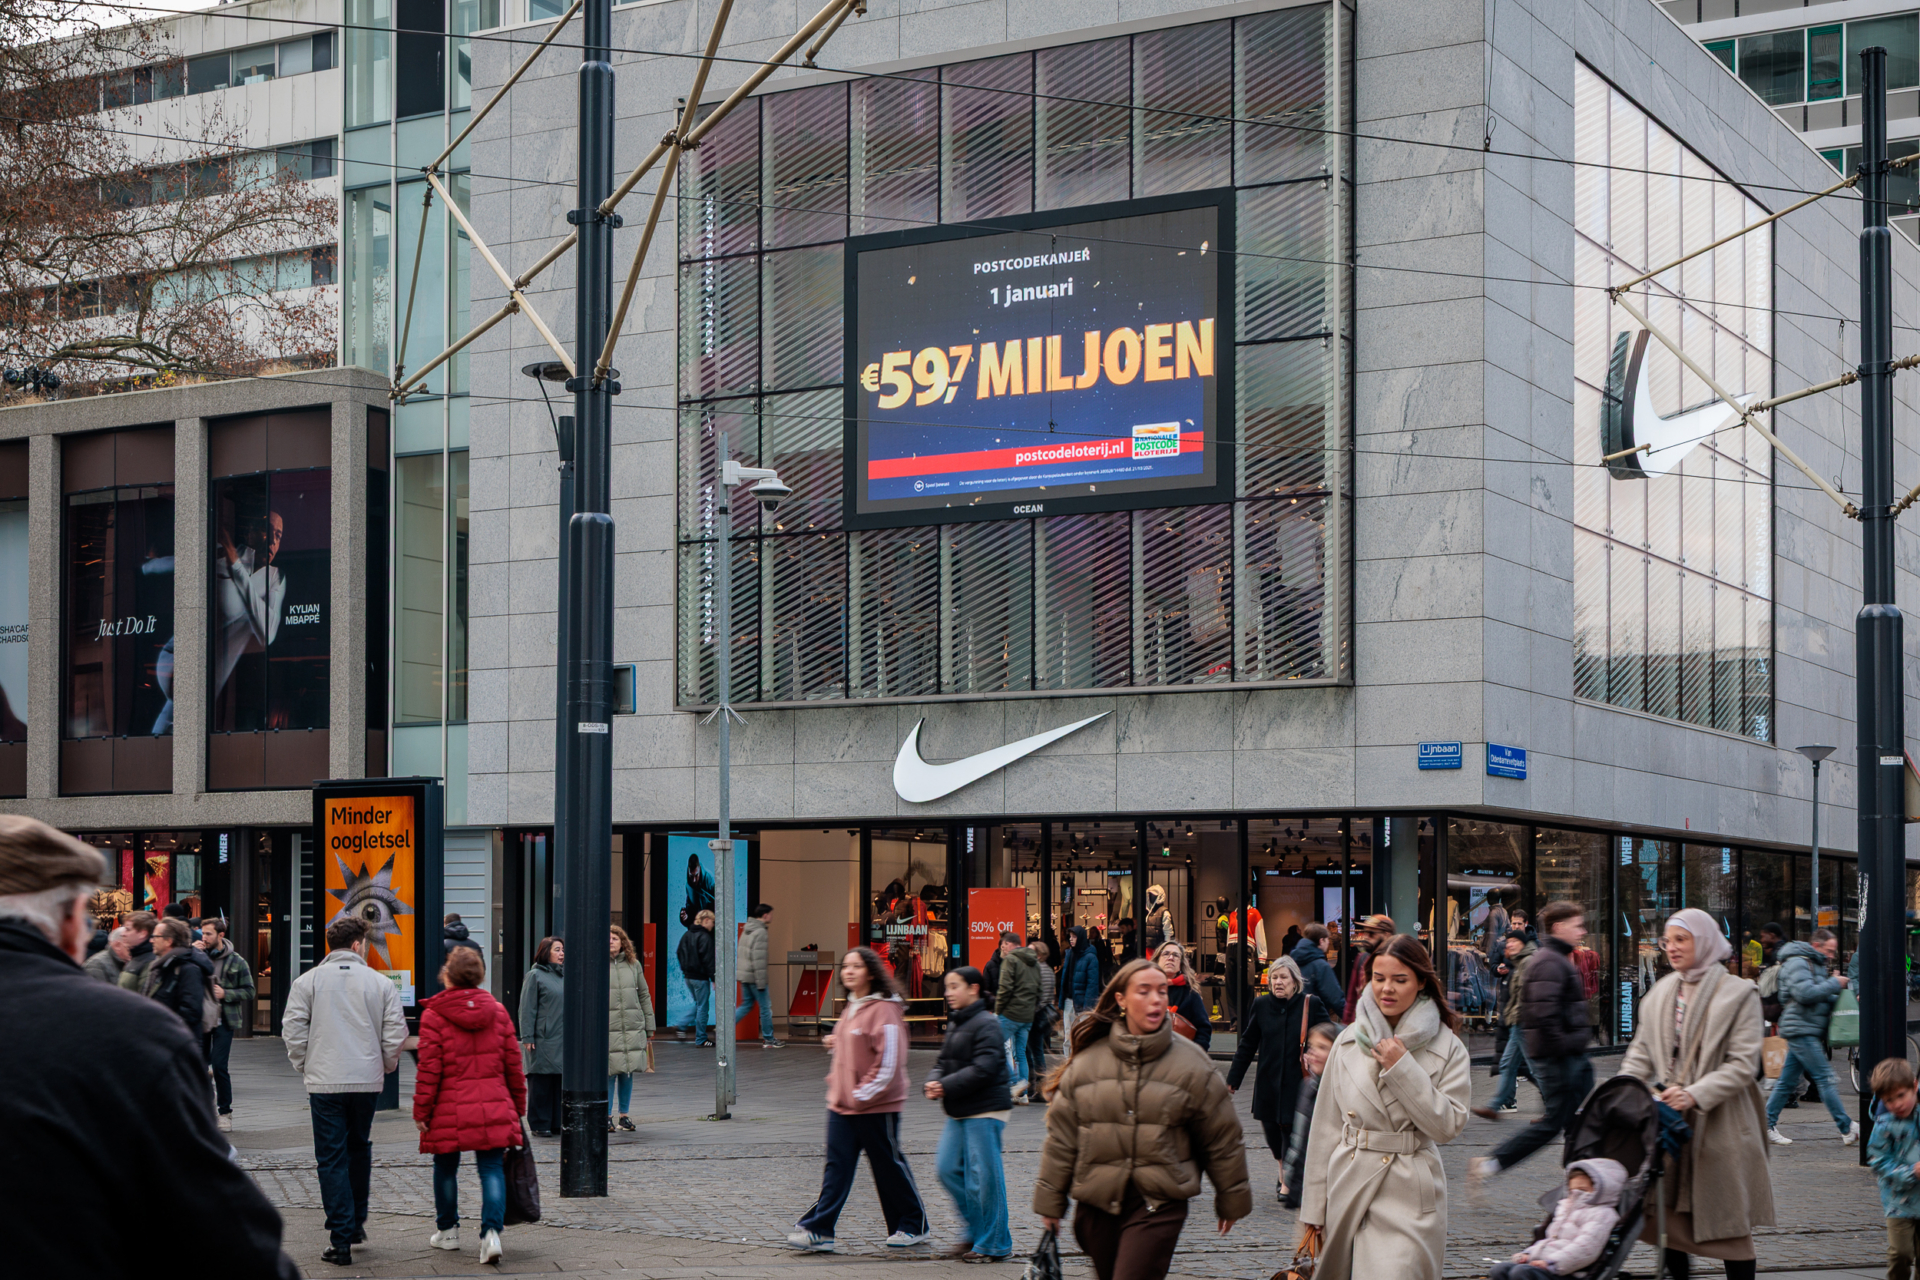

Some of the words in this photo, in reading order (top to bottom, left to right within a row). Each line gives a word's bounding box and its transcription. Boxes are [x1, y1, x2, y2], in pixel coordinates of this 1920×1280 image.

[973, 250, 1090, 275] POSTCODEKANJER
[990, 287, 999, 304] 1
[1004, 277, 1074, 308] januari
[976, 317, 1215, 400] MILJOEN
[1135, 440, 1178, 451] POSTCODE
[1015, 441, 1124, 465] postcodeloterij.nl
[1140, 449, 1172, 457] LOTERIJ
[1013, 504, 1043, 514] OCEAN
[290, 604, 320, 614] KYLIAN
[285, 612, 320, 625] MBAPPÉ
[94, 619, 123, 641] Just
[124, 616, 143, 635] Do
[144, 615, 157, 633] It
[1421, 745, 1457, 755] Lijnbaan
[1504, 748, 1512, 757] Van
[331, 805, 392, 825] Minder
[331, 829, 411, 853] oogletsel
[886, 924, 928, 935] LIJNBAAN
[971, 921, 995, 933] 50%
[997, 921, 1014, 932] Off
[1622, 981, 1633, 1032] LIJNBAAN
